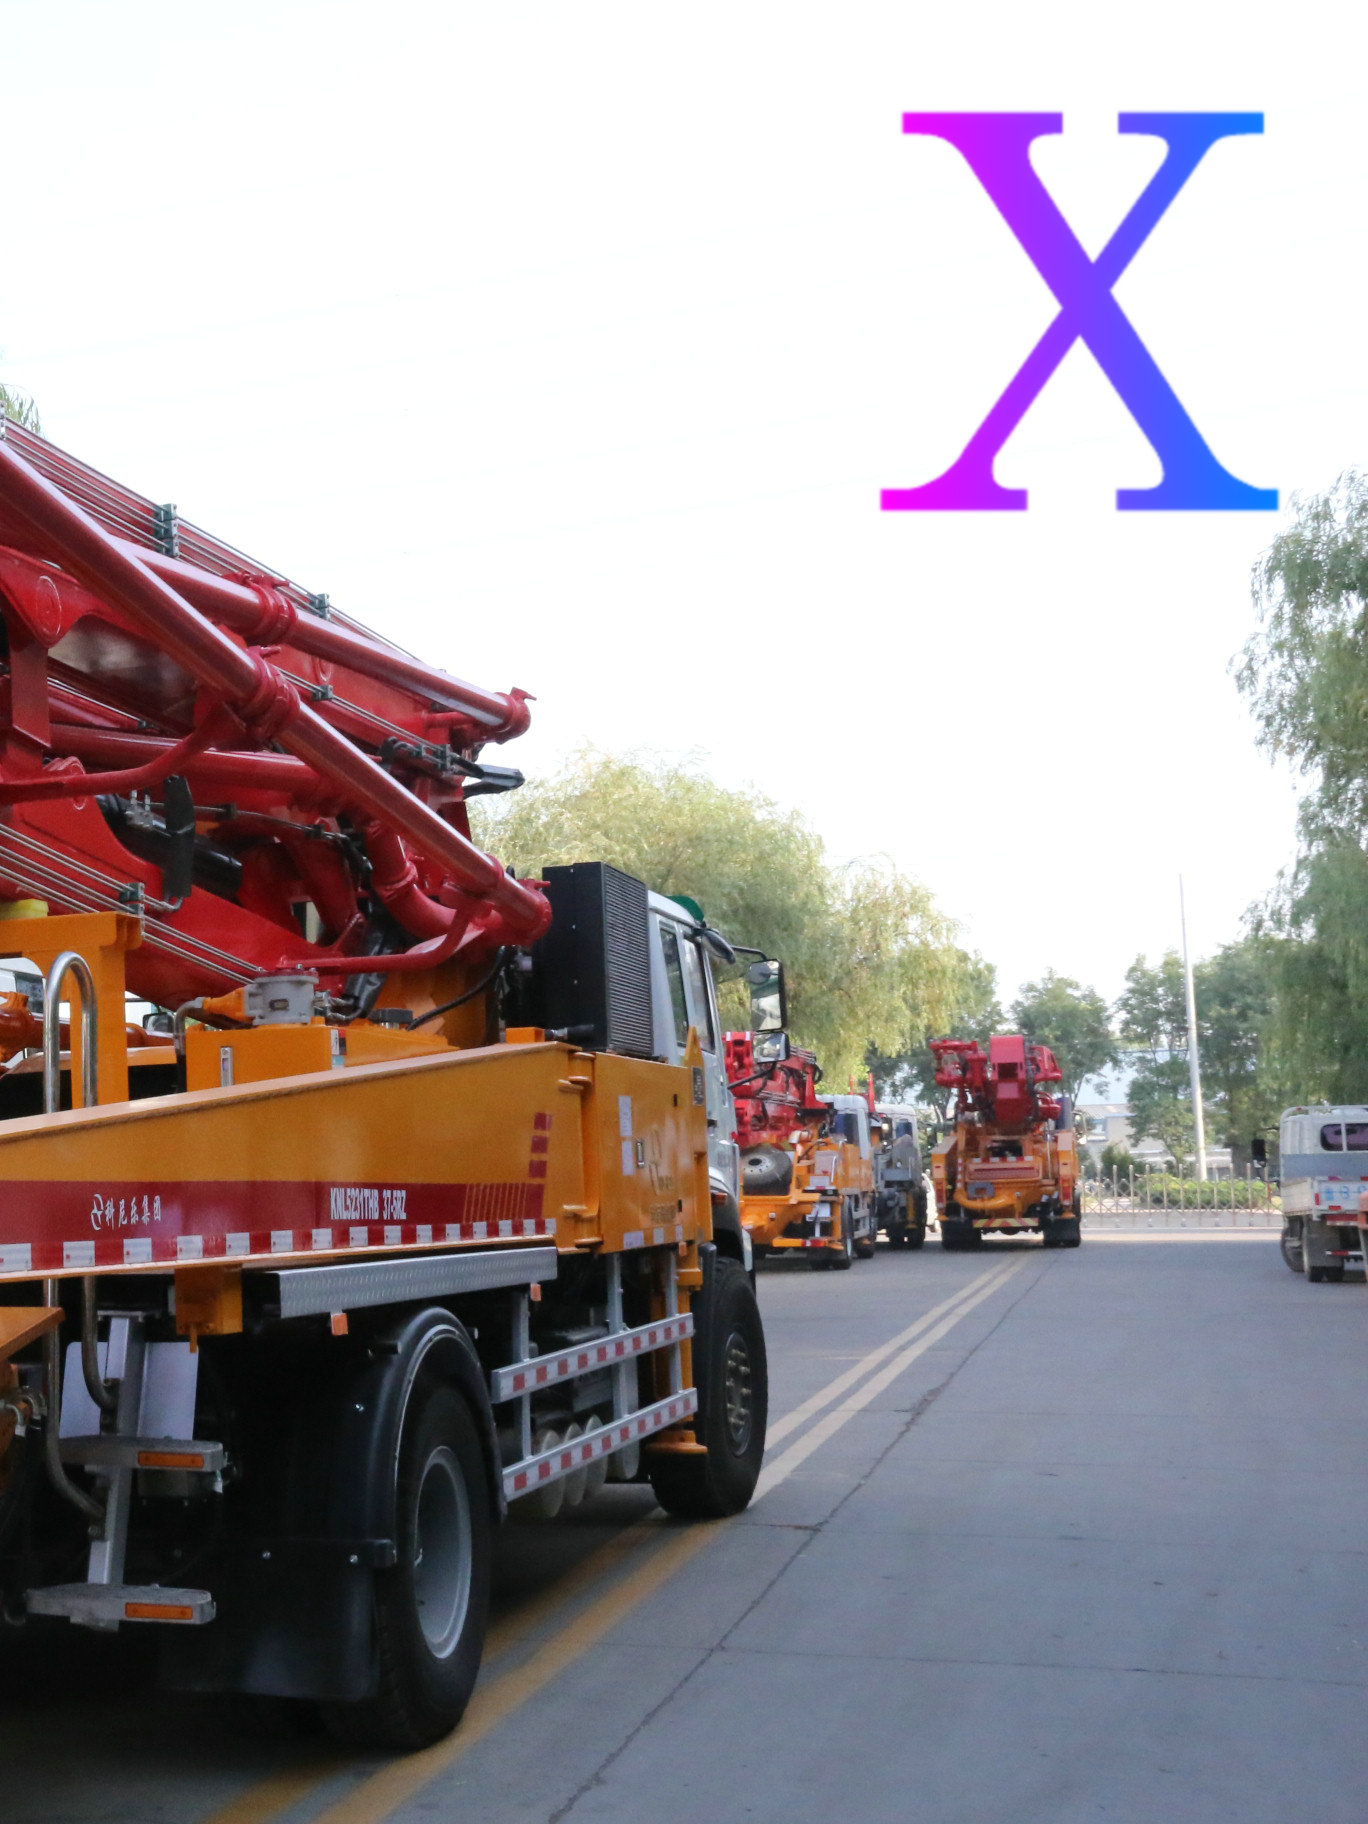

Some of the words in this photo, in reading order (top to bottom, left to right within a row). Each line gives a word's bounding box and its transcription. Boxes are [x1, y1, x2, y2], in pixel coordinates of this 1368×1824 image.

[105, 1195, 161, 1230] 科尼乐集团
[330, 1187, 380, 1220] KNL5231THB
